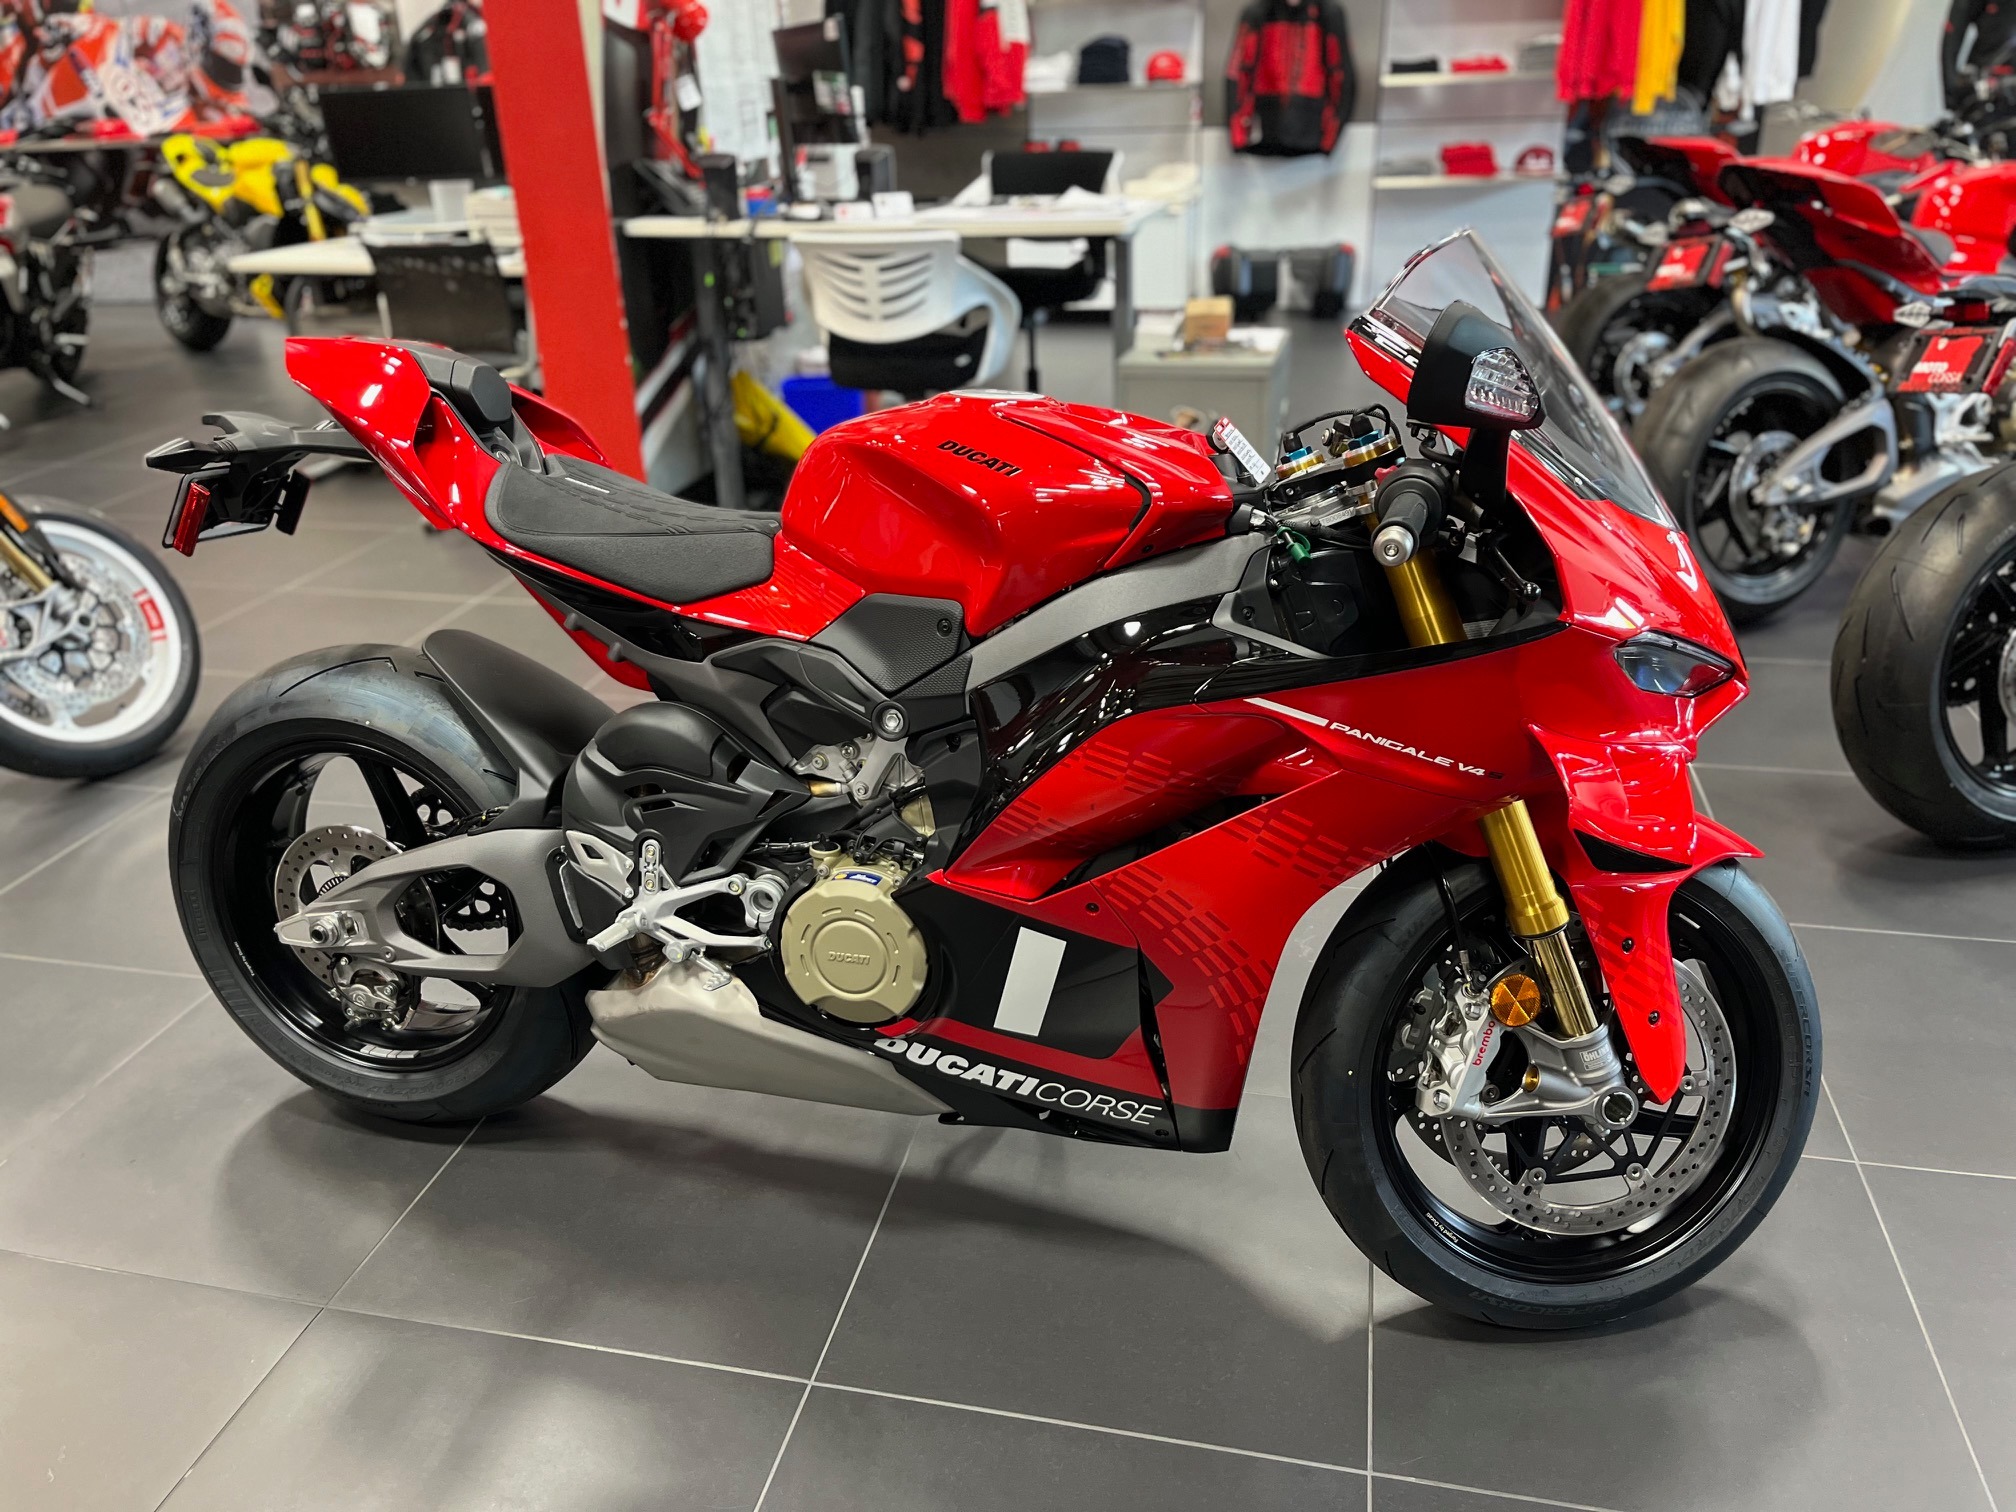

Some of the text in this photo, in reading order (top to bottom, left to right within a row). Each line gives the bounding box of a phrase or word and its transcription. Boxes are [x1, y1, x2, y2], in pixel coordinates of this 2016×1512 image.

[937, 440, 1023, 477] DUCATI
[1330, 722, 1504, 780] PANIGALE V4 S
[828, 951, 871, 966] DUCATI
[1472, 1020, 1495, 1066] brembo
[874, 1038, 1163, 1125] DUCATI CORSE
